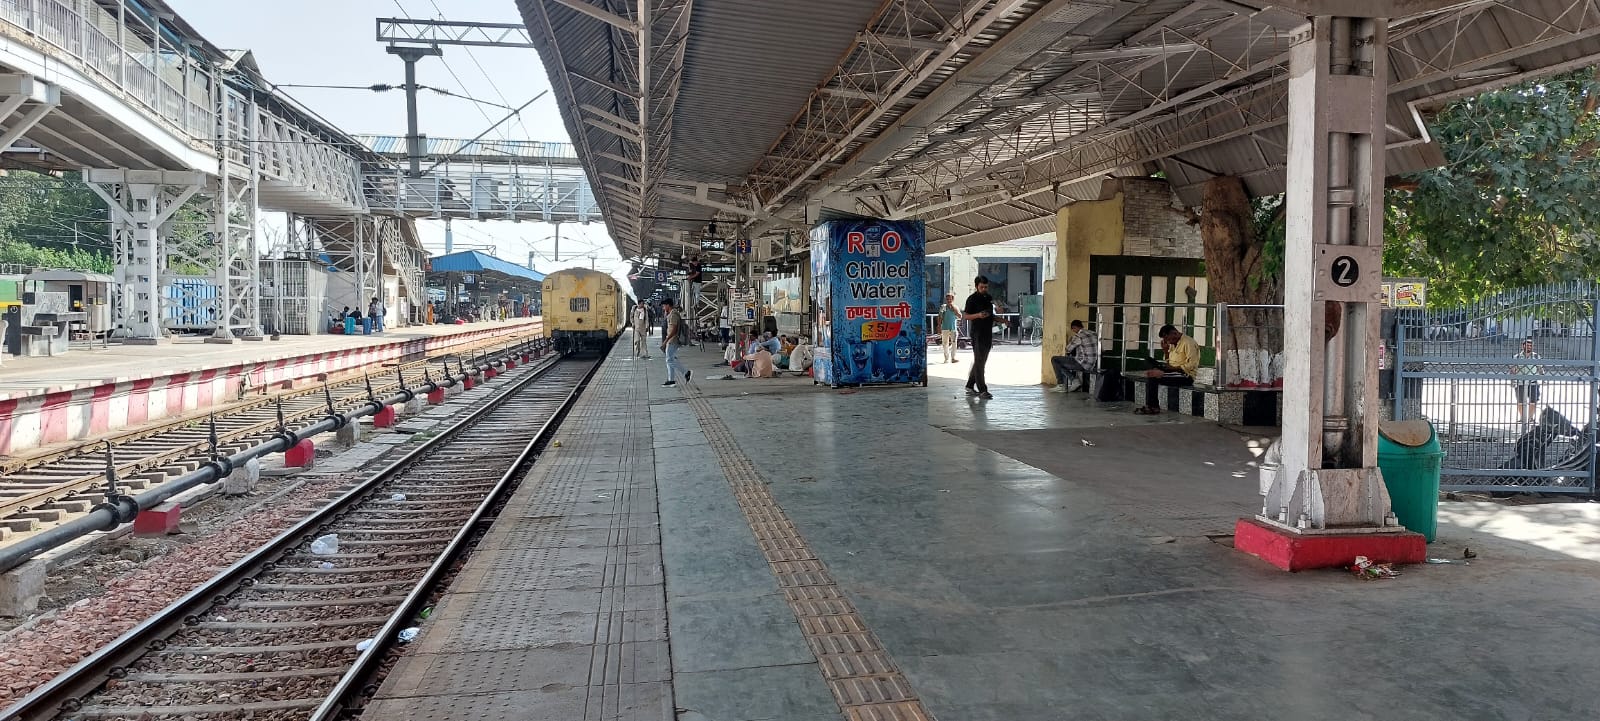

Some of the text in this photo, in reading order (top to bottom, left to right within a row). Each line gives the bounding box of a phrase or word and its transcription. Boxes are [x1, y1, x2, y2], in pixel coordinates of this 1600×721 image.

[848, 231, 901, 253] R O
[657, 272, 665, 282] 8
[846, 260, 909, 279] Chilled
[1338, 259, 1351, 283] 2
[850, 282, 905, 299] Water
[879, 301, 911, 319] पानी
